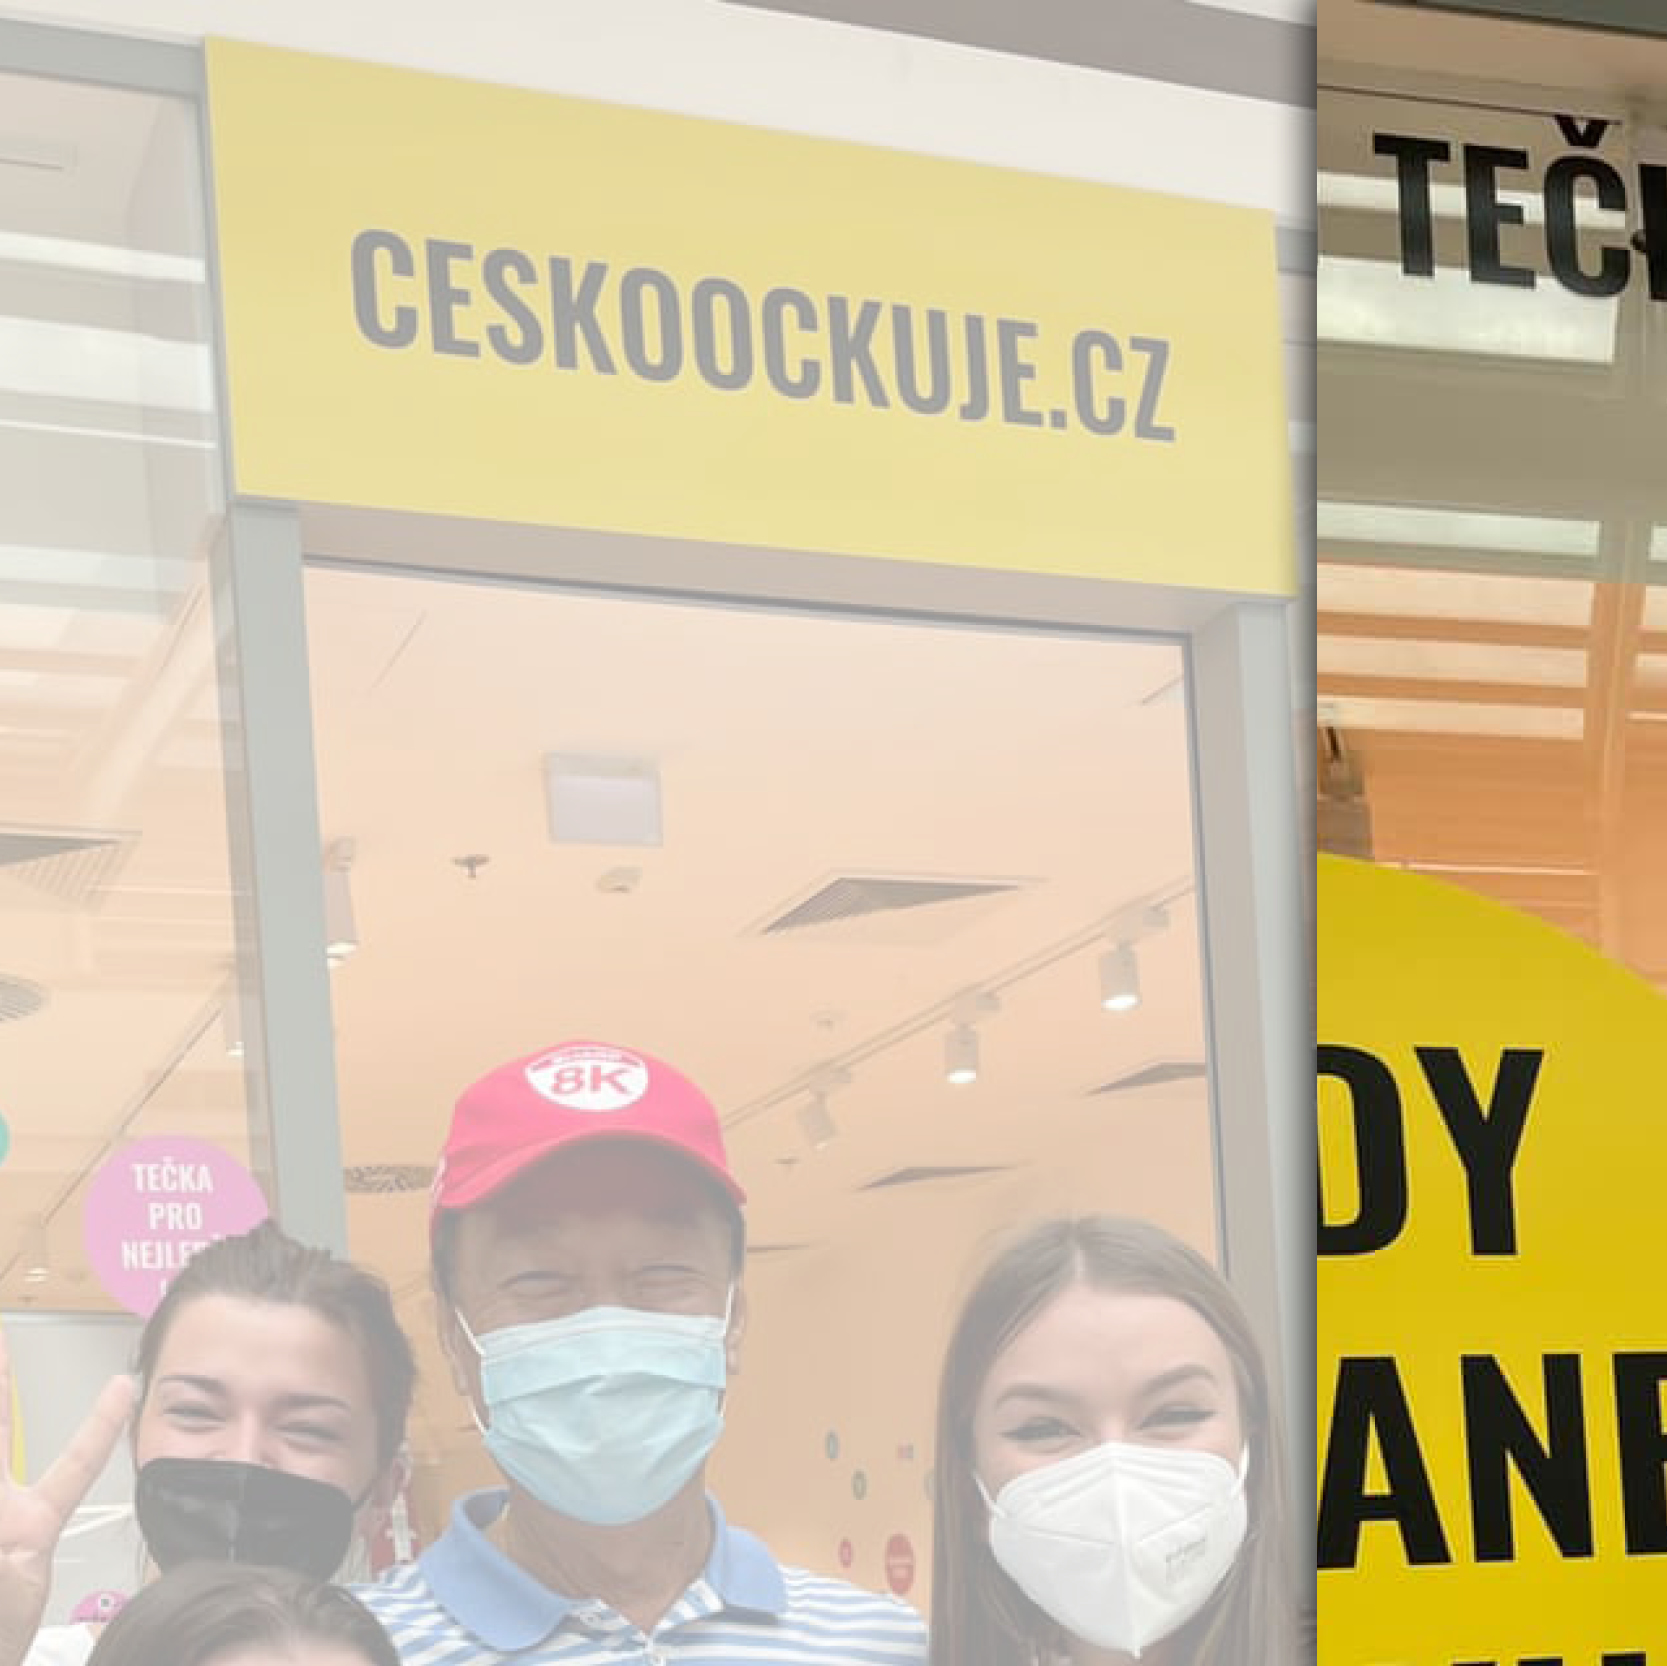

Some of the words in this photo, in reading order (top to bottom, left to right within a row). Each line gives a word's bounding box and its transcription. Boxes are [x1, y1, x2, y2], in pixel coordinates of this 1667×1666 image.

[349, 228, 1176, 442] CESKOOCKUJE.CZ
[131, 1156, 215, 1193] TEČKA
[148, 1202, 203, 1230] PRO
[121, 1234, 221, 1270] NEJLE
